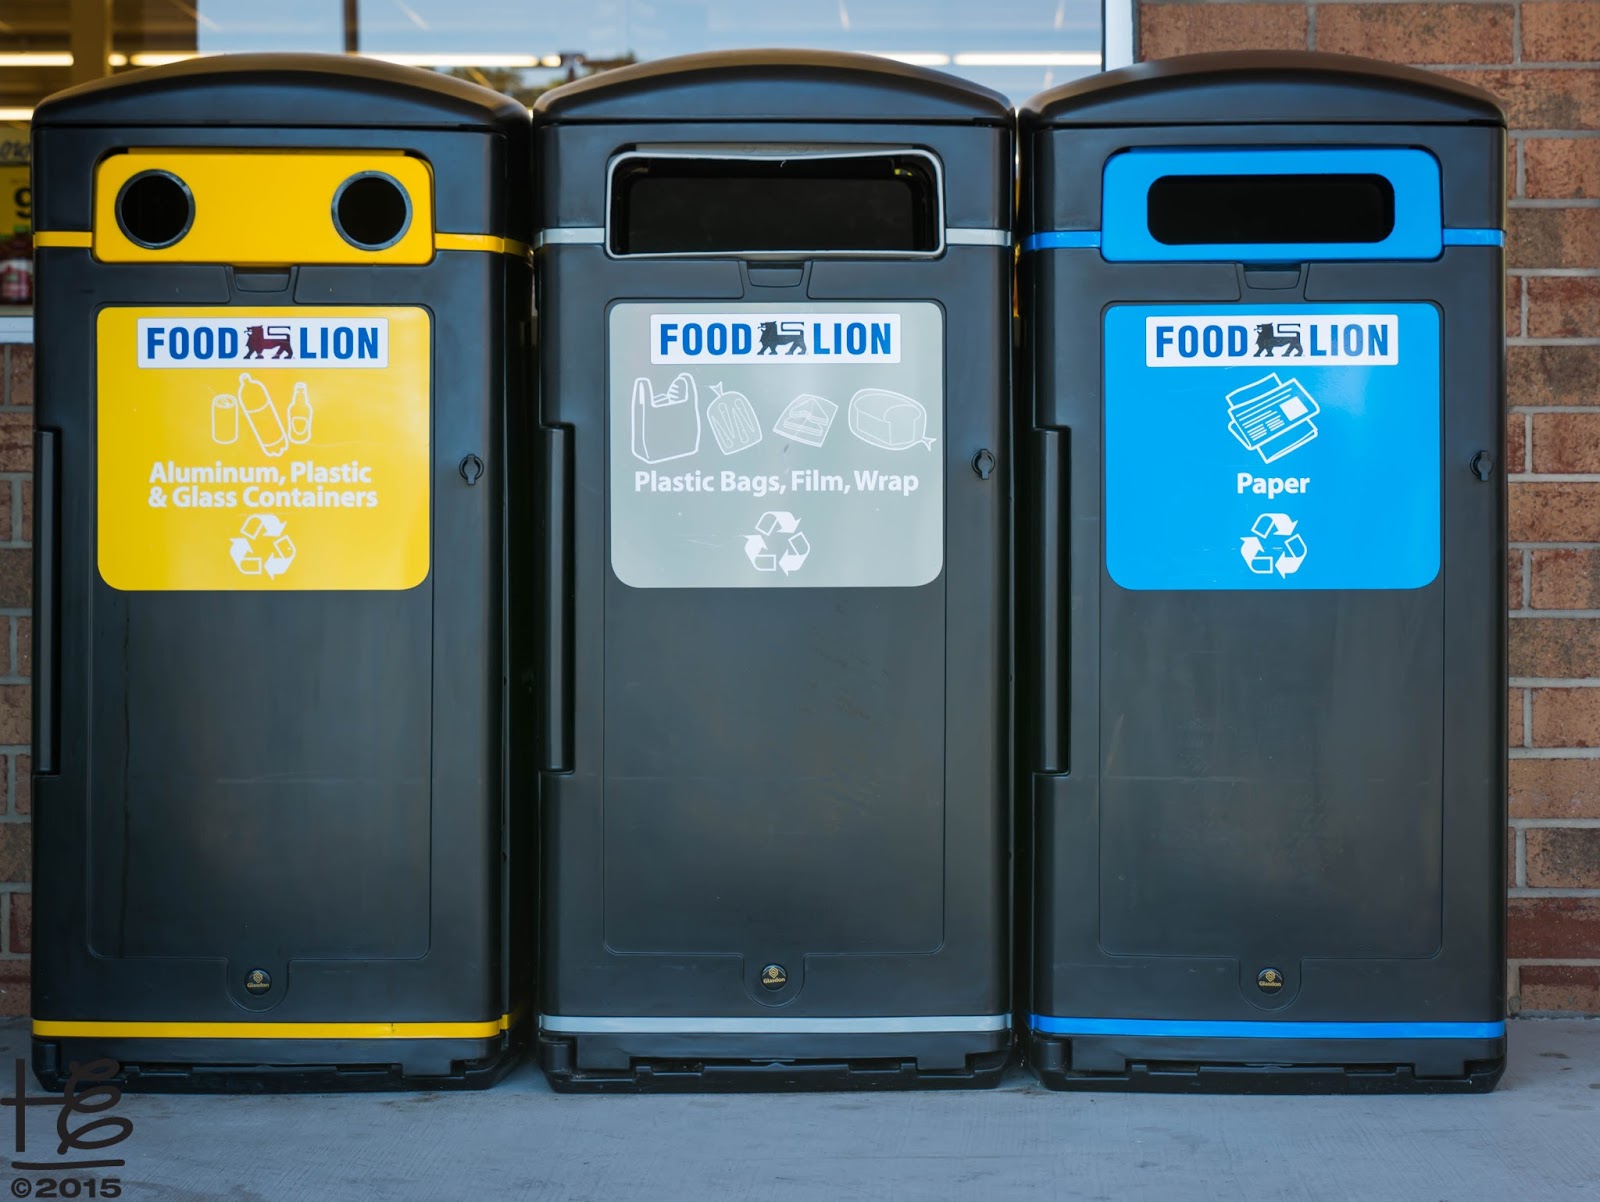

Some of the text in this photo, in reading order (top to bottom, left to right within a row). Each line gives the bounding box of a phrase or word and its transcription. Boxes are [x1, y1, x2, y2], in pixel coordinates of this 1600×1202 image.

[147, 326, 379, 360] FOOD LION
[660, 322, 891, 356] FOOD LION
[1156, 324, 1389, 358] FOOD LION
[149, 461, 373, 486] Aluminum, Plastic
[634, 470, 920, 498] Plastic Bags, Film, Wrap
[1237, 472, 1311, 500] Paper
[148, 486, 379, 509] & Glass Containers
